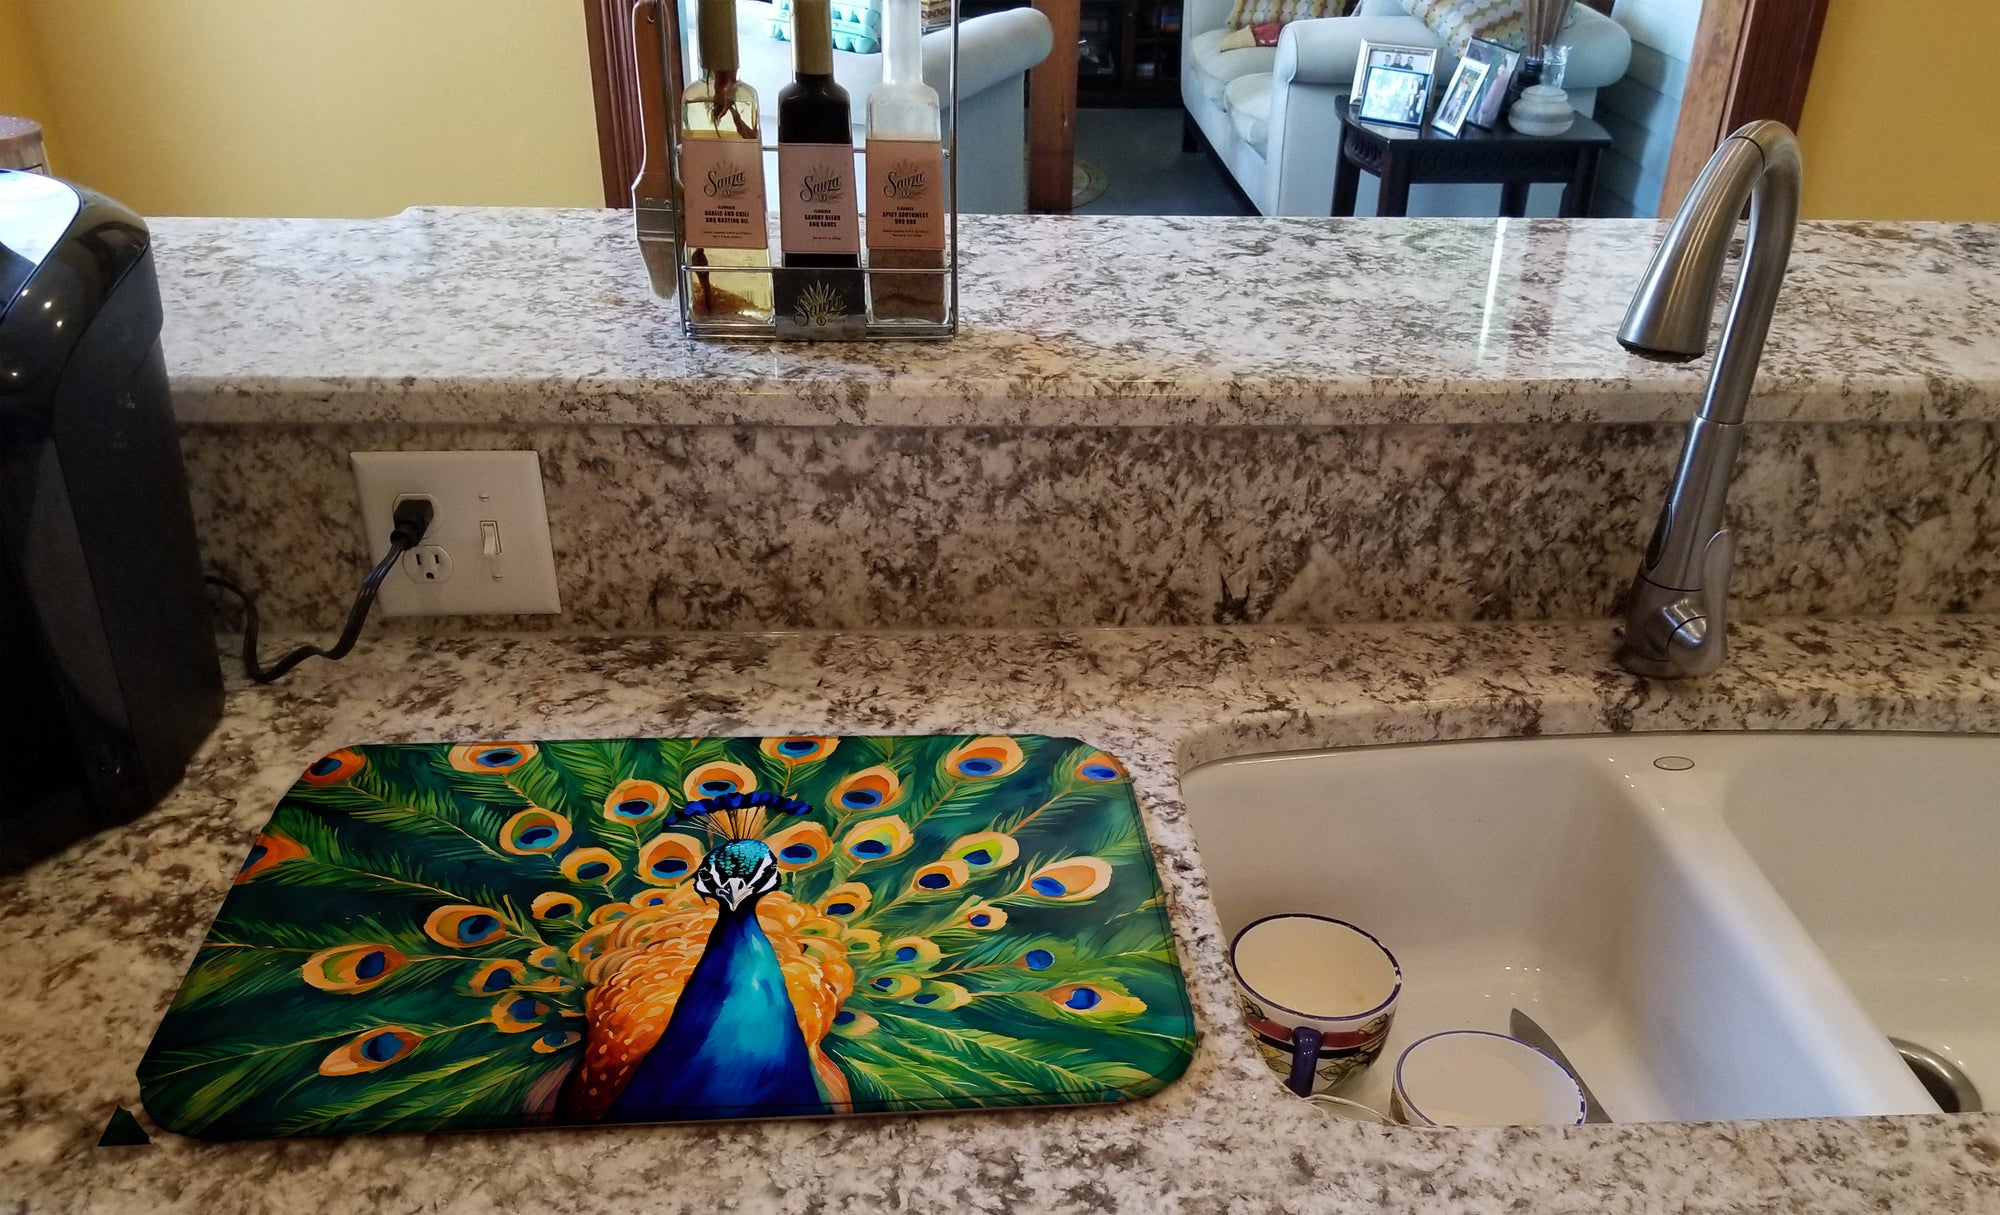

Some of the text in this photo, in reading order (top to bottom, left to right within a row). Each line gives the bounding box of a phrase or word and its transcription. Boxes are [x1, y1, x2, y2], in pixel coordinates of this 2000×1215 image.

[703, 170, 745, 197] Sauza
[800, 175, 841, 202] Sauza
[883, 171, 924, 198] Sauza
